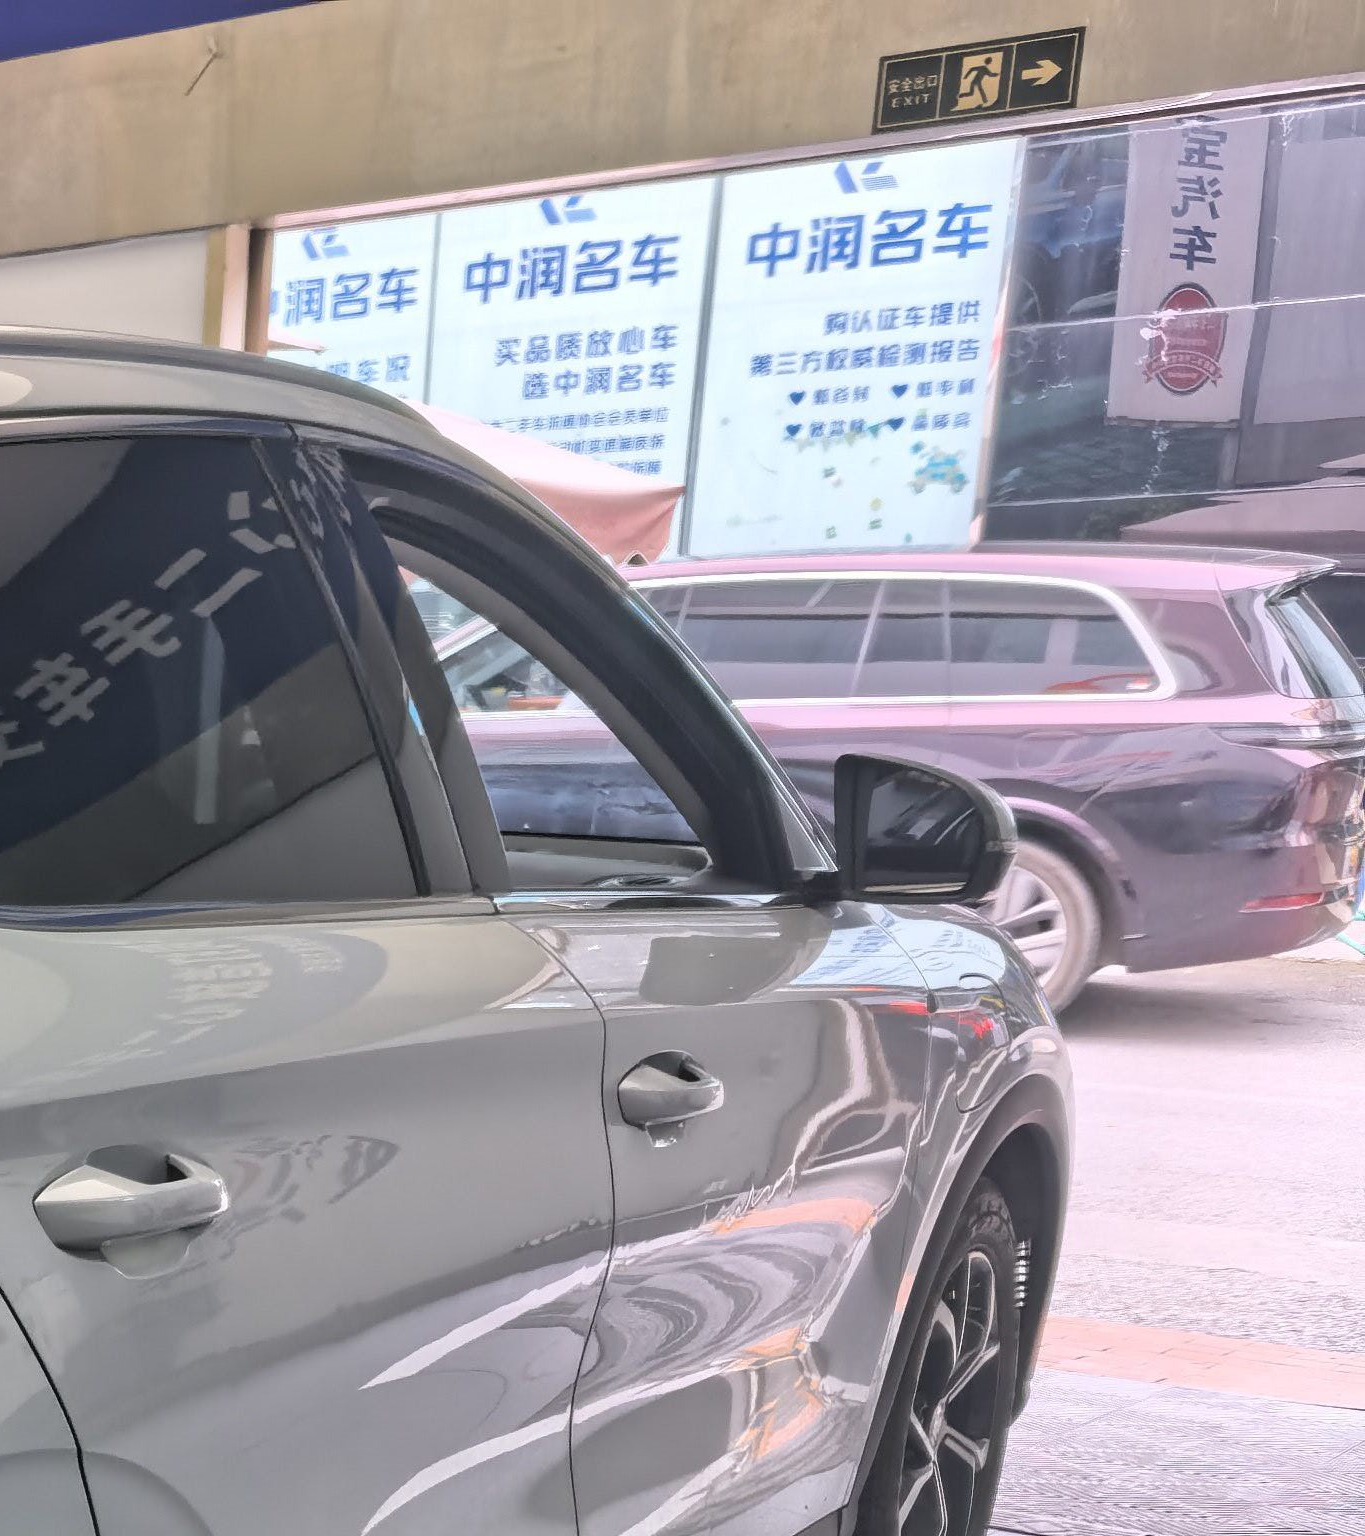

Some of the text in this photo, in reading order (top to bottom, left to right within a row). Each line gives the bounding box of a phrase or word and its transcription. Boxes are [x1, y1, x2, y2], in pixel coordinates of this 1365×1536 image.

[887, 74, 938, 95] 安全出口
[891, 93, 931, 109] EXIT
[744, 201, 994, 279] 中润名车
[464, 233, 681, 306] 中润名车
[494, 324, 681, 367] 买品质放心车
